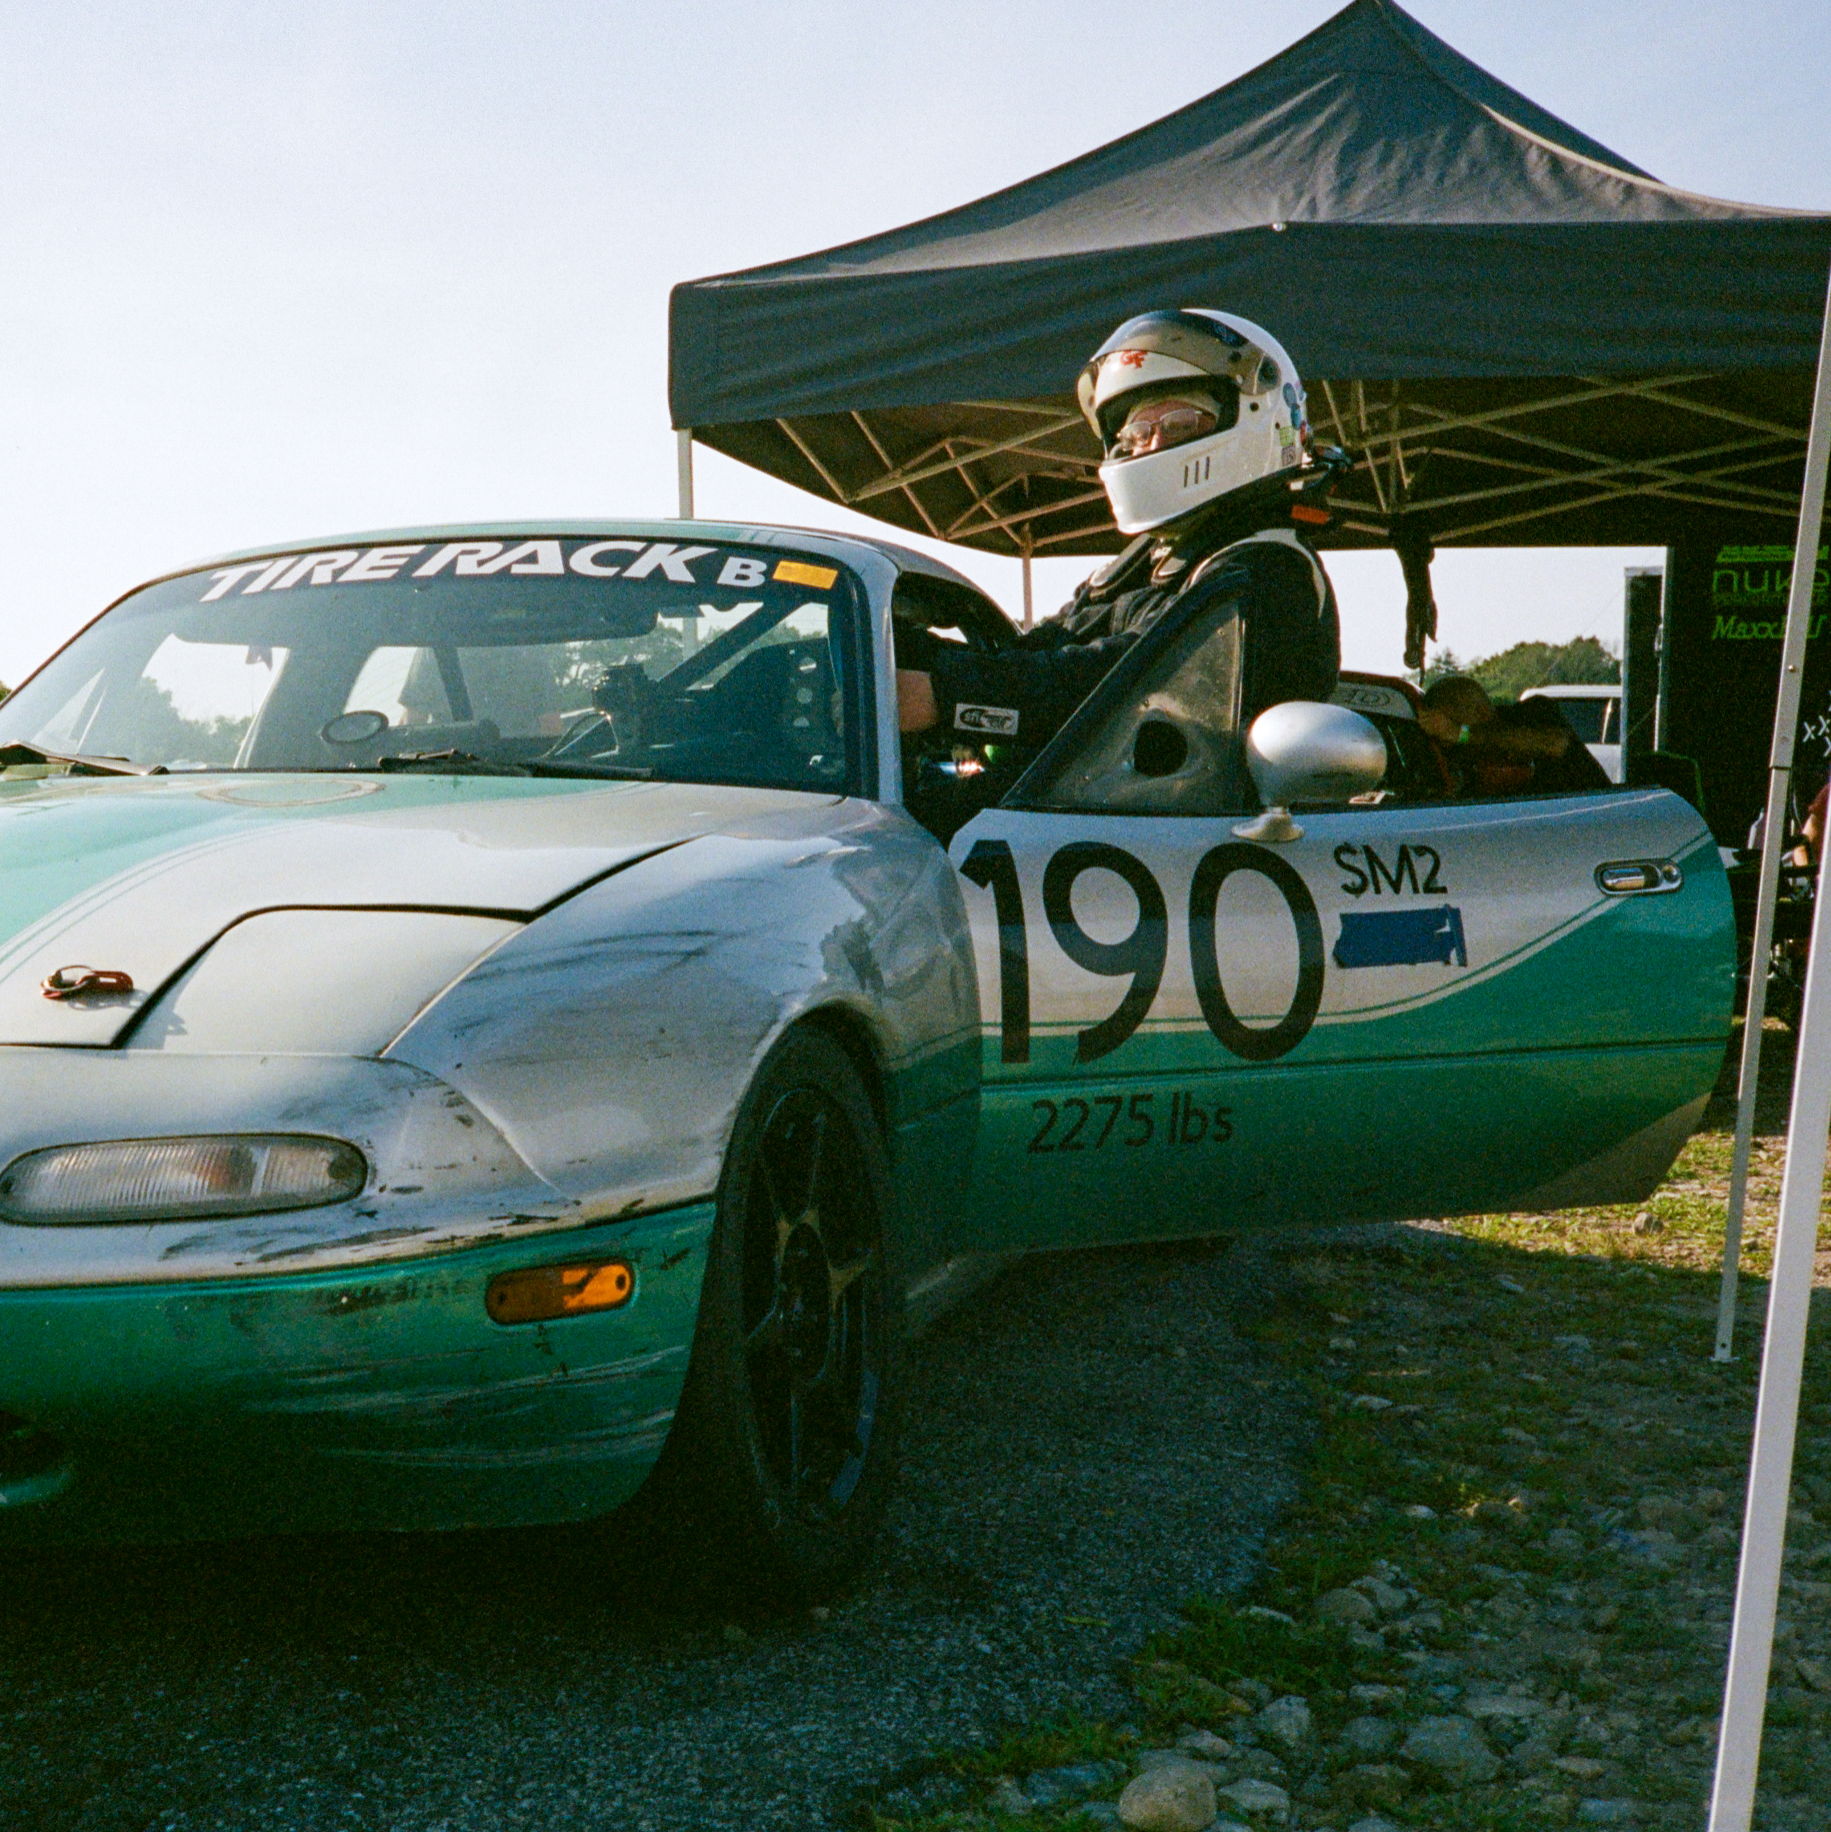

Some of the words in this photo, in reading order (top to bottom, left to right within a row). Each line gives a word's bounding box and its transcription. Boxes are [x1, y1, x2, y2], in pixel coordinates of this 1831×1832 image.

[716, 555, 768, 588] B
[1333, 841, 1448, 899] SM2
[959, 838, 1326, 1066] 190
[1027, 1094, 1156, 1155] 2275
[1167, 1091, 1235, 1146] lbs
